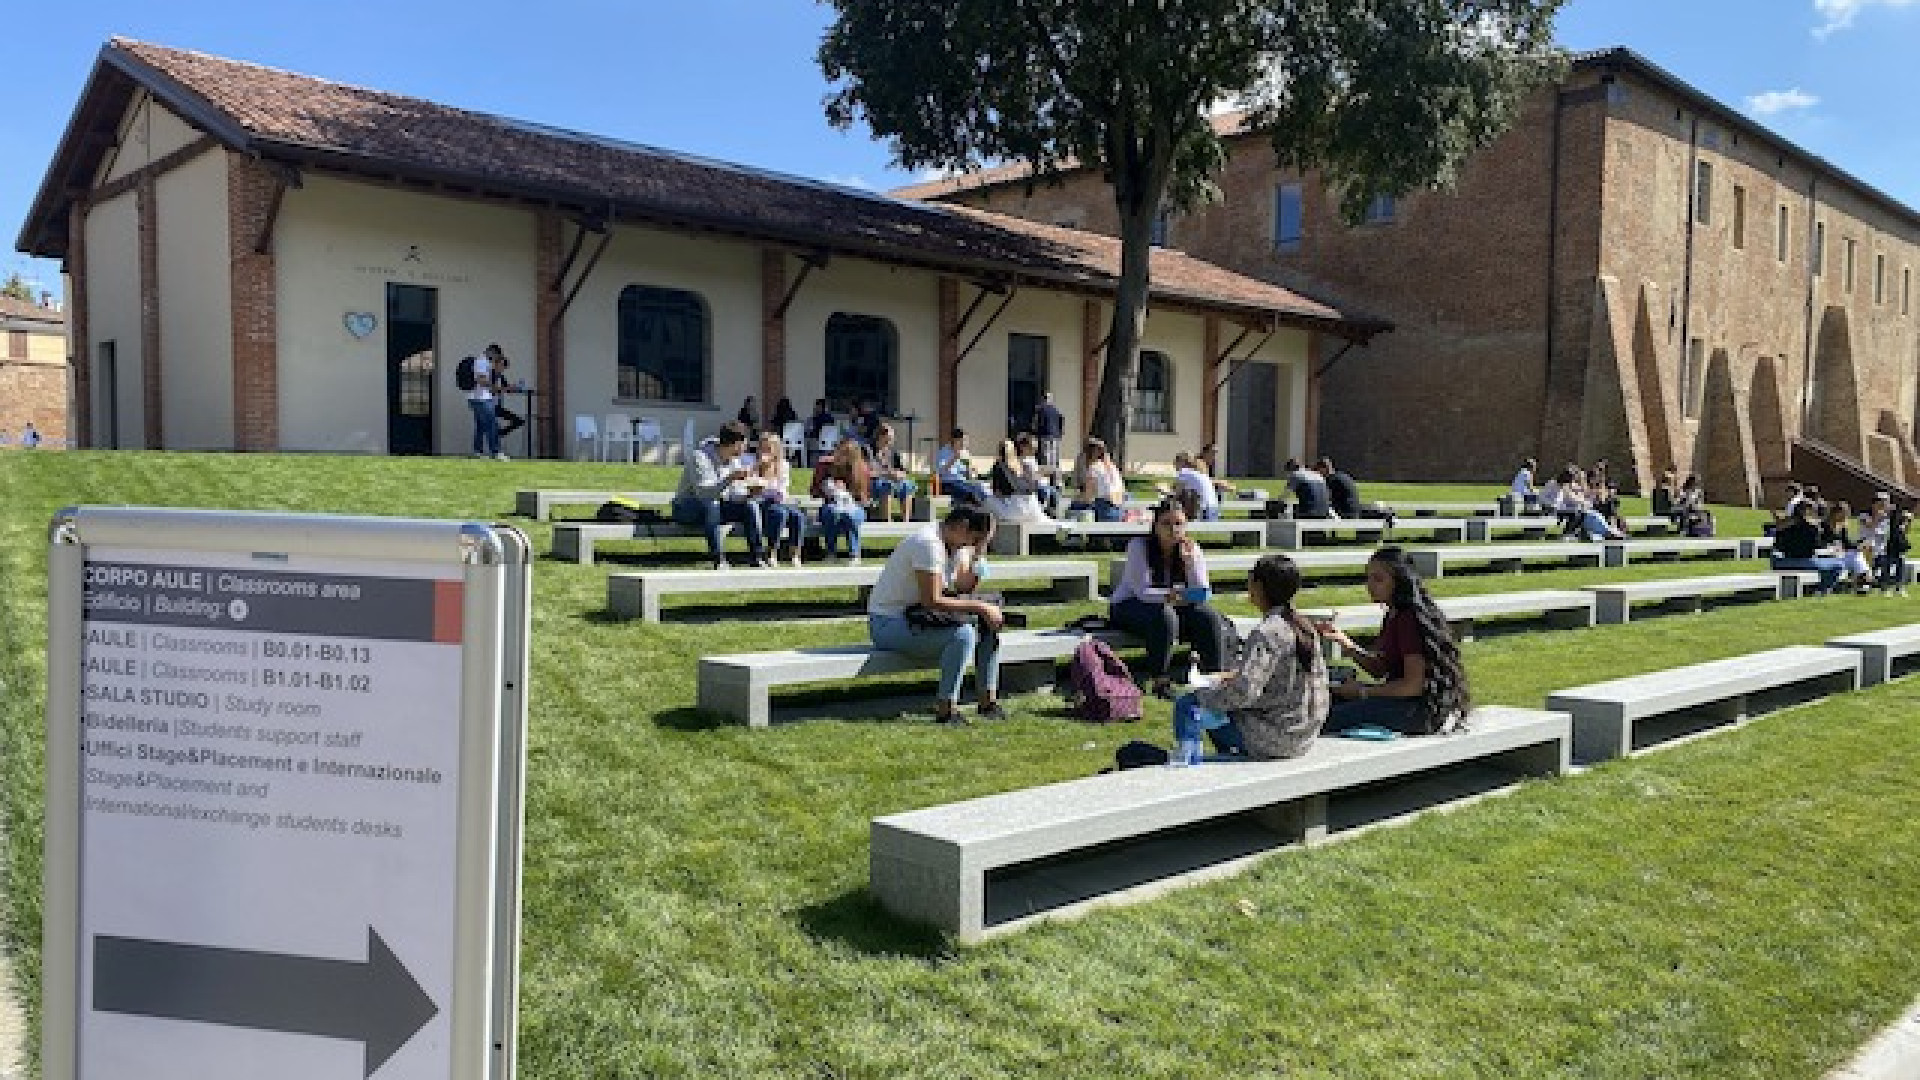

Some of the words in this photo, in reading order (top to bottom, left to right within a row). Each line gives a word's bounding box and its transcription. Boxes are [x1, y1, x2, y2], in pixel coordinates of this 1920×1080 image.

[152, 571, 202, 588] AULE
[218, 575, 317, 595] Classrooms
[321, 583, 361, 598] area
[88, 630, 136, 647] AULE
[152, 633, 247, 655] Classrooms
[263, 643, 371, 662] B0.01-B0.13
[88, 658, 136, 675] AULE
[152, 663, 247, 684] Classrooms
[263, 671, 371, 691] B1.01-B1.02
[86, 684, 136, 702] SALA
[140, 688, 209, 708] STUDIO
[225, 695, 271, 715] Study
[276, 702, 321, 715] room
[86, 713, 169, 732] Bidelleria
[256, 727, 319, 745] support
[323, 731, 364, 746] staff
[86, 741, 133, 759] Uffici
[137, 744, 292, 771] Stage&Placement
[297, 761, 308, 771] e
[313, 759, 442, 783] Internazionale
[86, 769, 232, 795] Stage&Placement
[237, 781, 269, 797] and
[275, 812, 347, 833] students
[351, 817, 403, 836] desks
